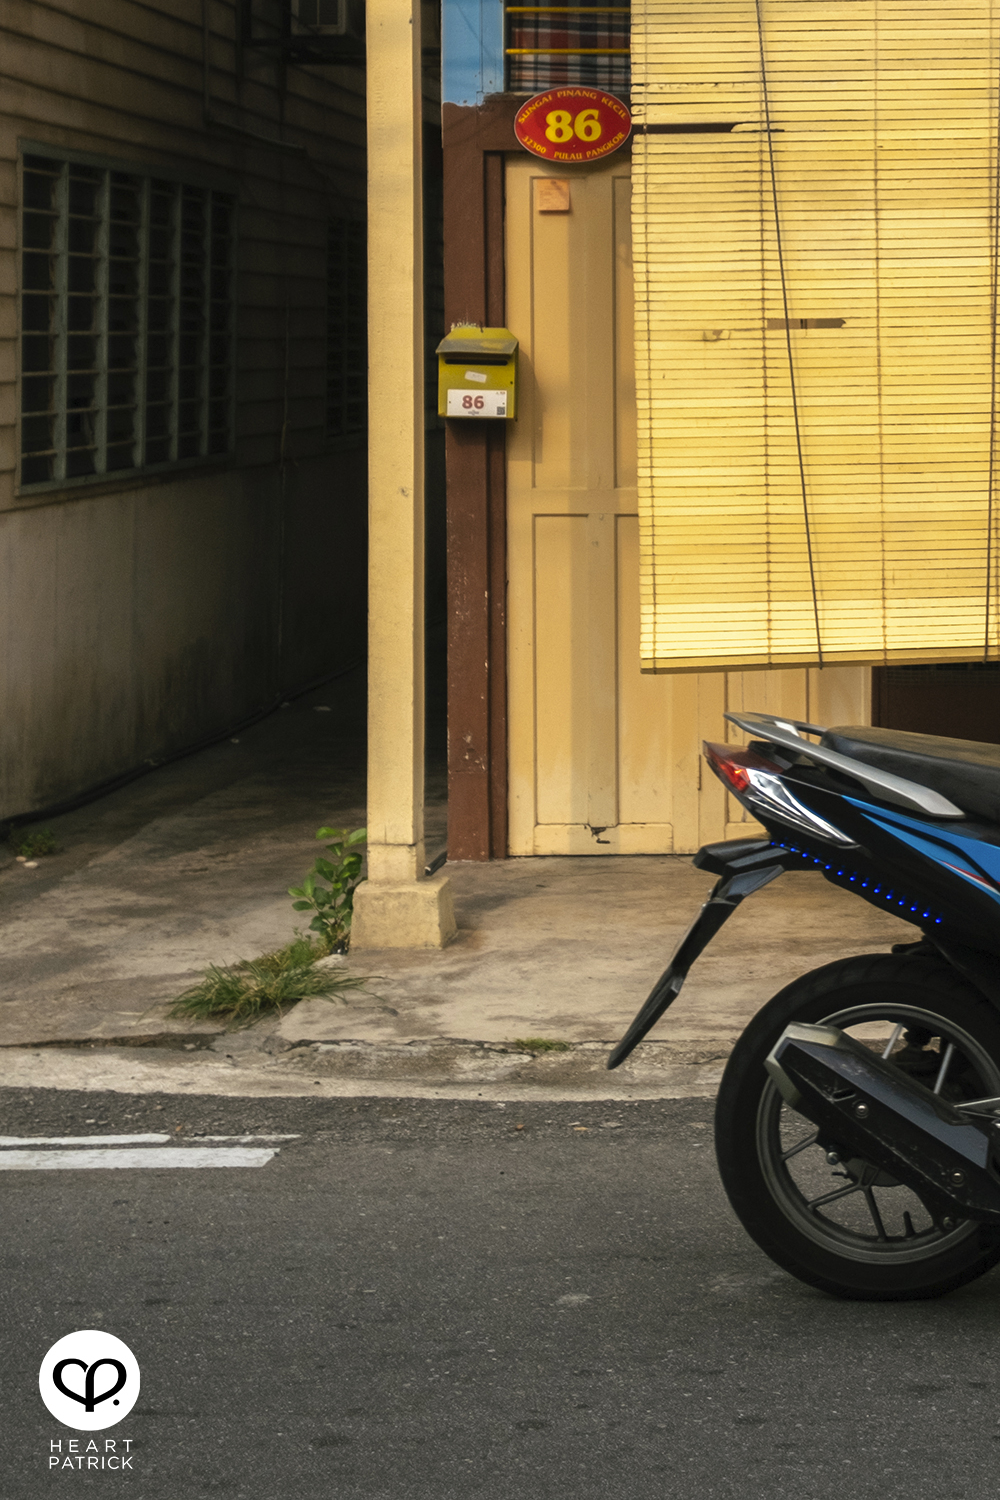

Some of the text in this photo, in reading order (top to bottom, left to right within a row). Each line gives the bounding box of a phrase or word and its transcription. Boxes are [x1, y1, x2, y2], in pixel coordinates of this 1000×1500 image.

[518, 89, 627, 124] SUNGAI PINANG KECIL
[545, 108, 602, 143] 86
[522, 132, 625, 160] 32300 PULAU PANGKOR
[462, 395, 485, 410] 86
